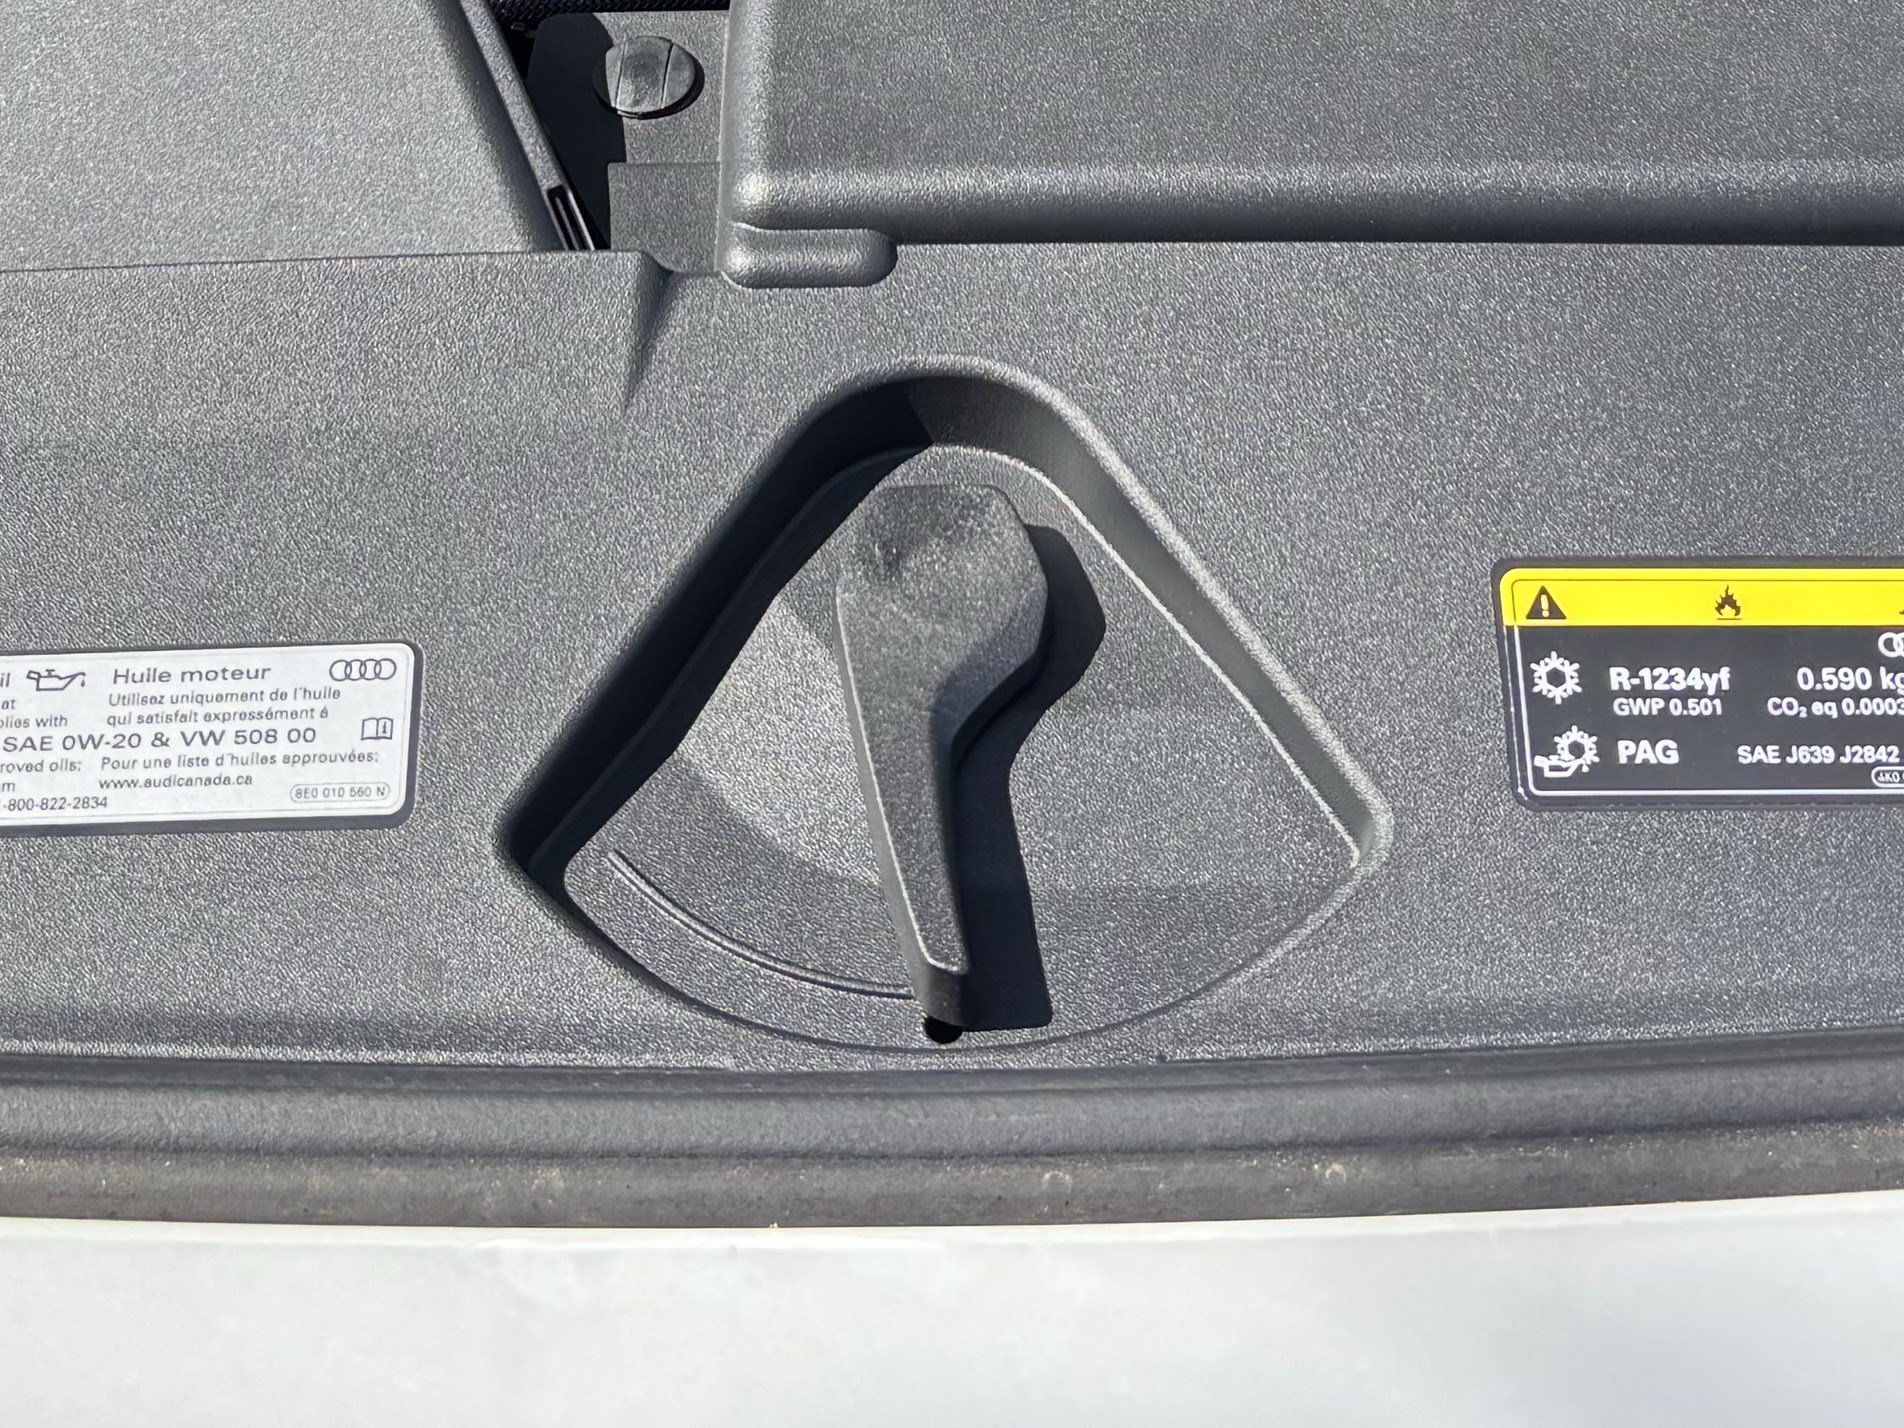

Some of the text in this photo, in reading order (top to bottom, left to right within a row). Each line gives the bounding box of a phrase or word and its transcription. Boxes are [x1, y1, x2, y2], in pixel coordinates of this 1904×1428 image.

[113, 666, 271, 684] Huile moteur
[1609, 666, 1731, 695] R-1234yf
[1797, 667, 1872, 691] 0.590
[109, 686, 341, 706] Utilisez uniquement de l'huile
[107, 713, 131, 726] qui
[137, 710, 198, 723] satisfait
[204, 707, 314, 723] expressément
[1614, 699, 1665, 715] GWP
[1669, 698, 1722, 715] 0.501
[1812, 701, 1838, 718] eq
[36, 715, 68, 727] with
[3, 727, 316, 752] SAE 0W-20 & VW 508 00
[101, 757, 136, 771] Pour
[143, 758, 172, 769] une
[177, 754, 210, 768] liste
[215, 752, 277, 768] d'huiles
[1617, 740, 1680, 764] PAG
[1738, 745, 1781, 764] SAE
[1786, 745, 1835, 763] J639
[1840, 745, 1900, 763] J2842
[99, 773, 252, 790] www.audicanada.ca
[323, 787, 345, 797] 010
[377, 786, 385, 796] N
